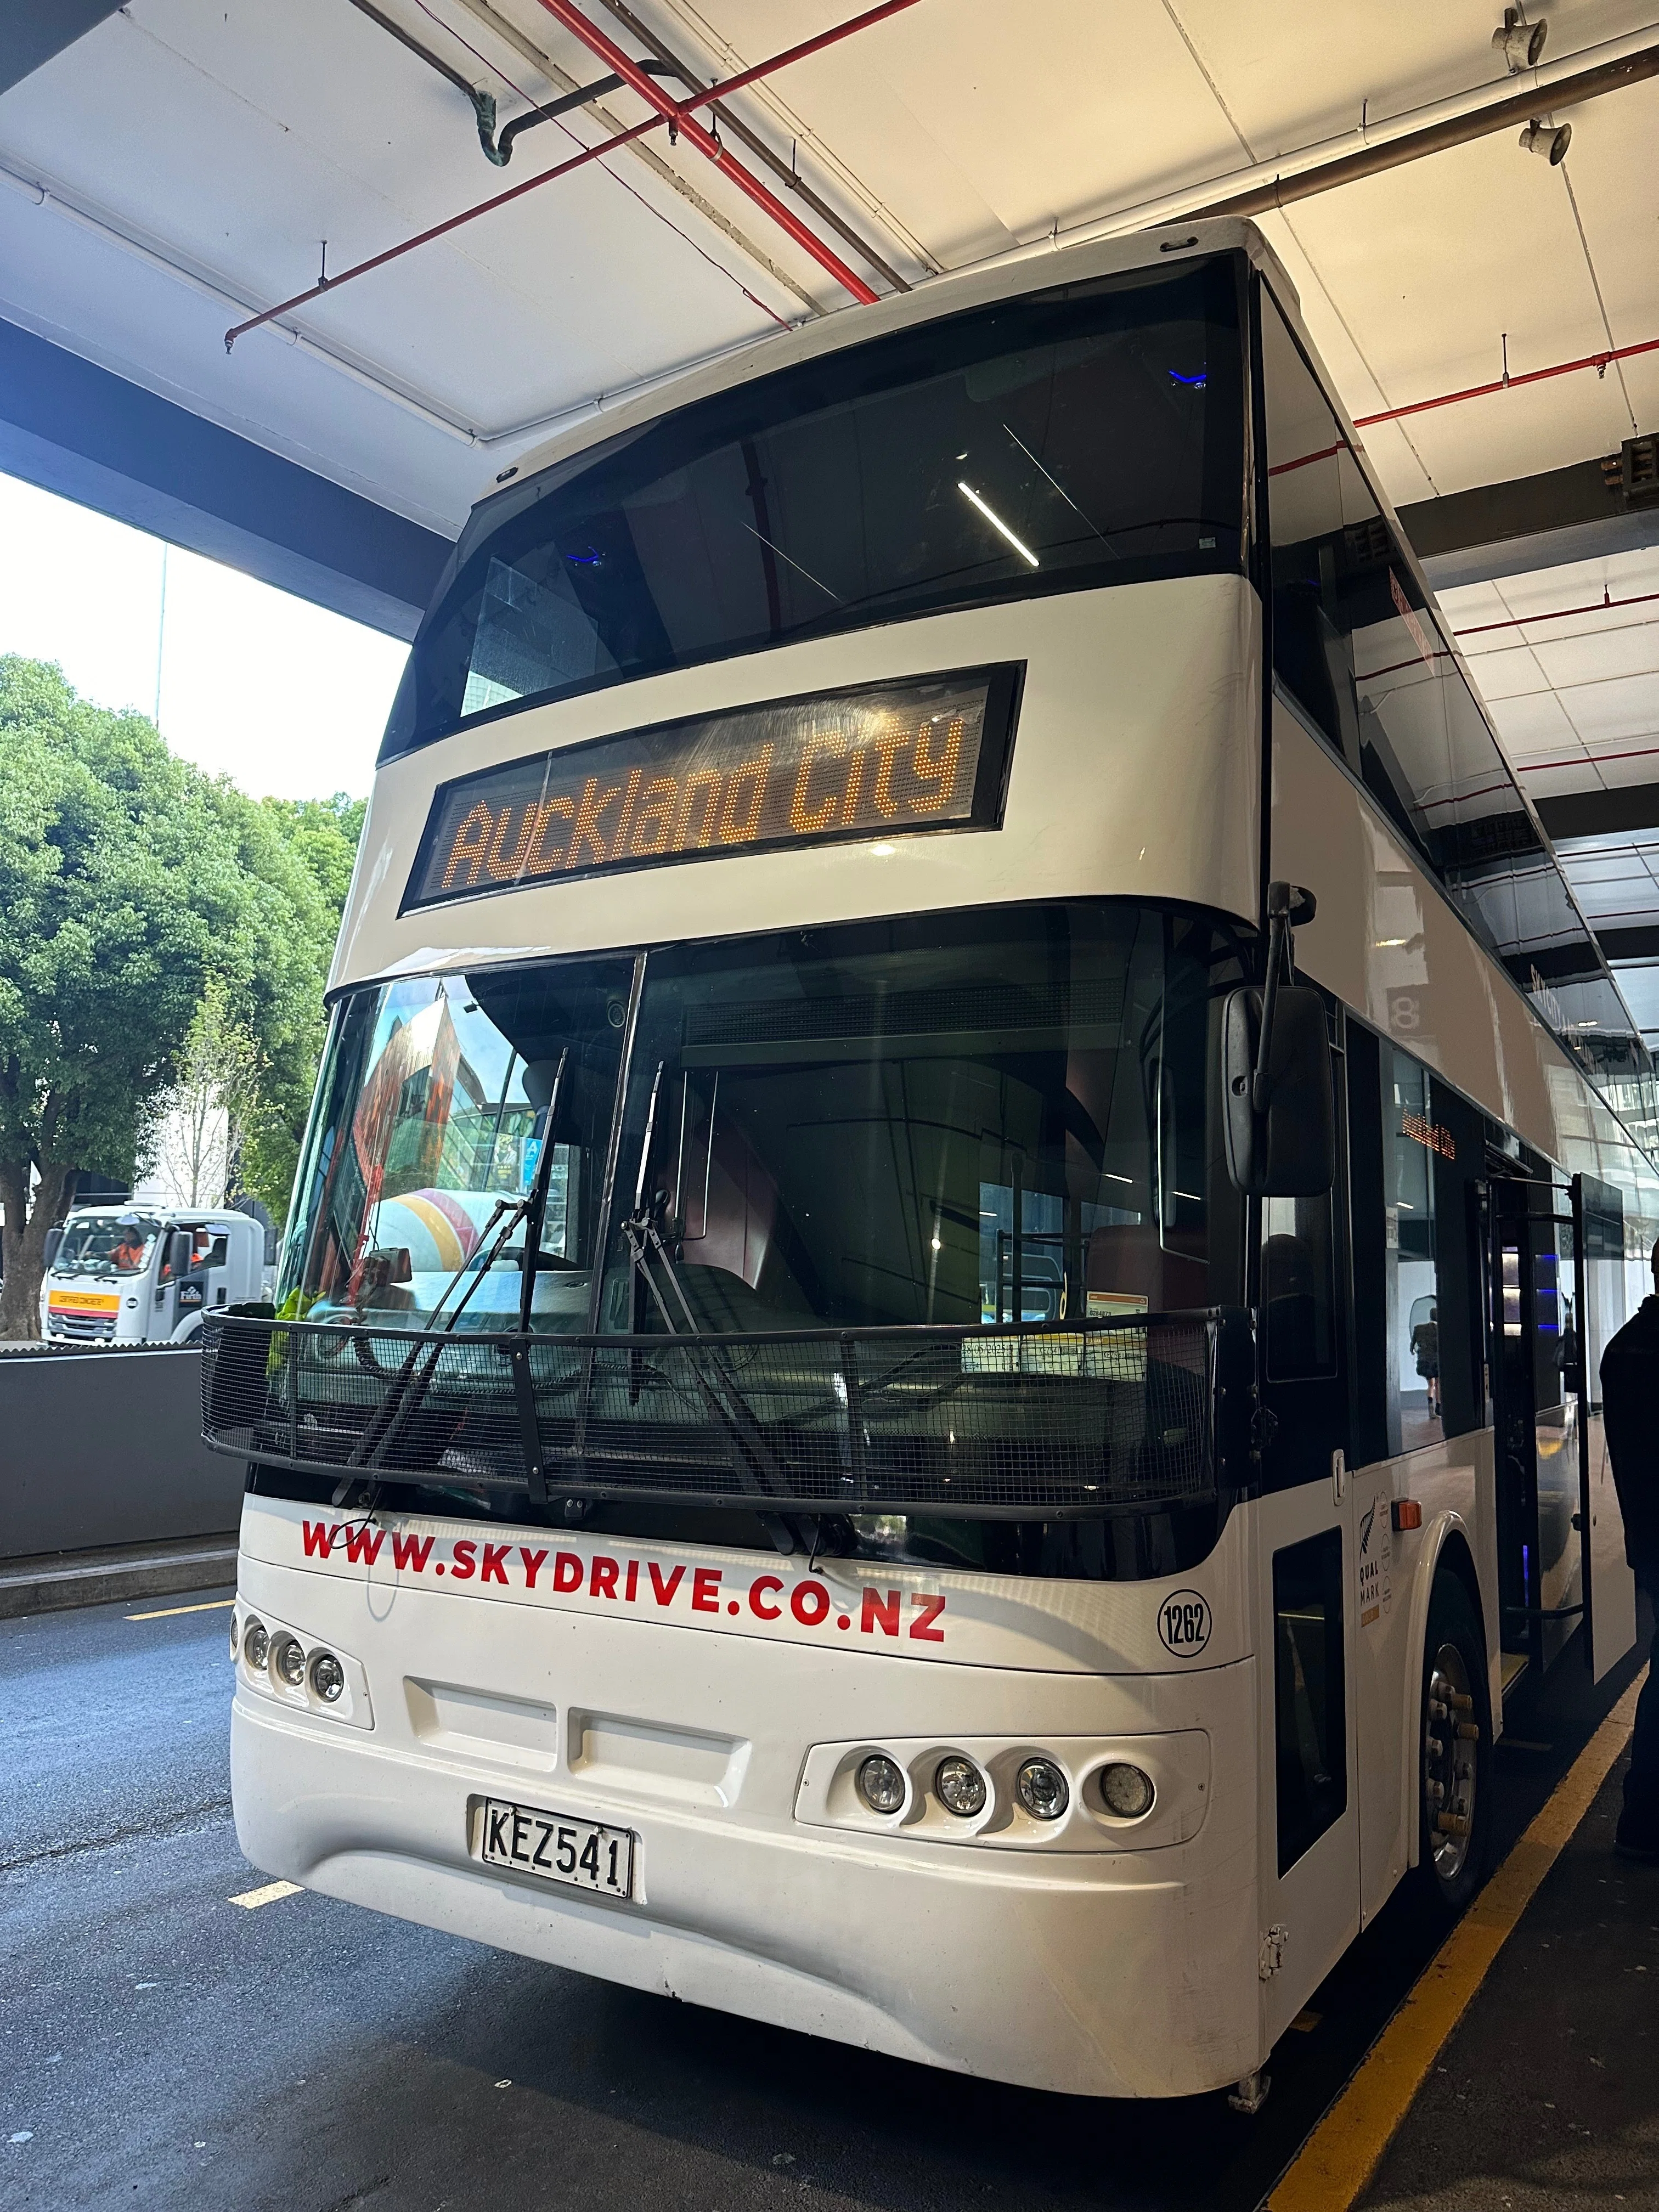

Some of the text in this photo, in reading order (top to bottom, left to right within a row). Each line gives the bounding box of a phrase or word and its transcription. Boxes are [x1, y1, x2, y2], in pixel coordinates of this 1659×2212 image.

[440, 714, 964, 889] Auckland City
[180, 1291, 201, 1300] Firth
[302, 1520, 946, 1643] WWW.SKYDRIVE.CO.NZ
[1360, 1560, 1378, 1586] QUAL
[1361, 1581, 1379, 1606] MARK
[1164, 1602, 1205, 1644] 1262
[489, 1809, 618, 1886] KEZ541
